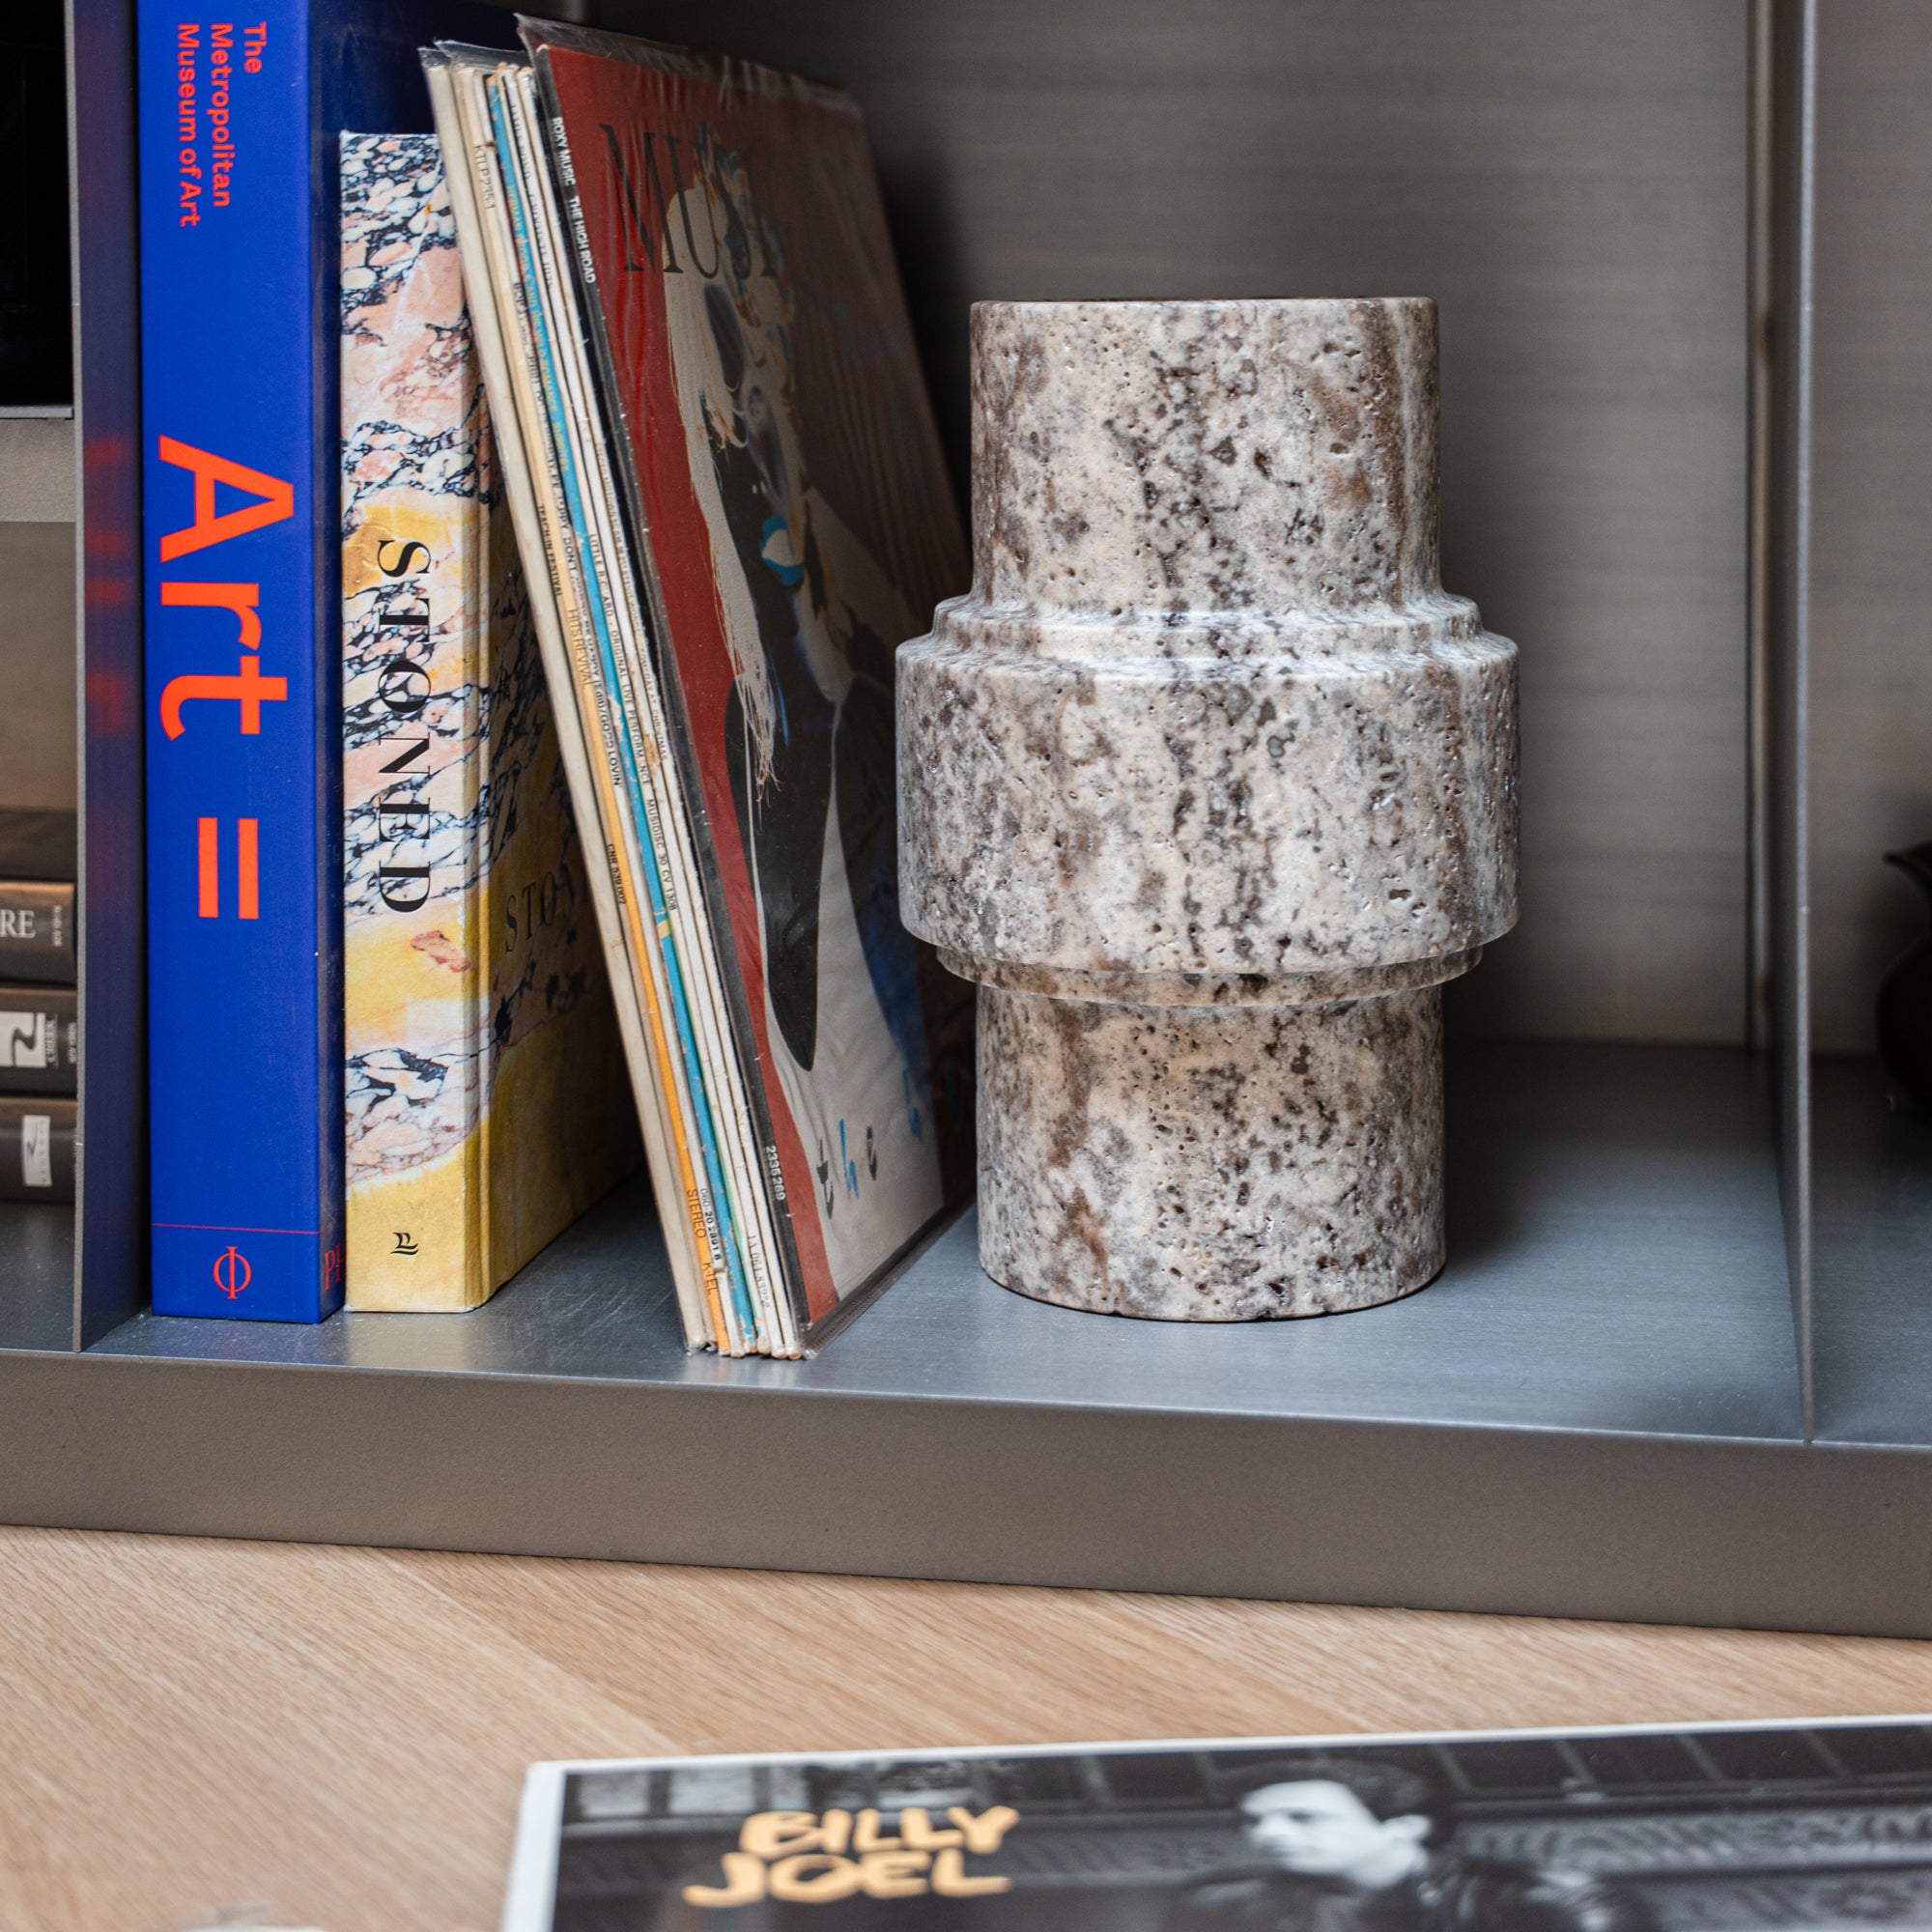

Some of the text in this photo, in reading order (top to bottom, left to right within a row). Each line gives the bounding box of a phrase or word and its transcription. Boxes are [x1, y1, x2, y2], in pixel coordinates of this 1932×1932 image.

[244, 21, 266, 72] The
[178, 24, 202, 226] Museum of Art
[207, 23, 235, 206] Metropolitan
[551, 116, 596, 283] ROXY MUSIC THE HIGH ROAD
[158, 435, 294, 740] Art
[546, 552, 563, 598] FESTIVAL
[565, 609, 583, 637] HITS
[573, 638, 594, 687] REVIVAL
[609, 629, 628, 677] ORIGINAL
[620, 683, 634, 703] LIVE
[378, 538, 431, 912] STONED
[644, 798, 665, 849] MUSIDISC
[606, 843, 618, 864] CNR
[657, 854, 668, 866] 30
[661, 869, 672, 883] CV
[665, 888, 678, 910] 1308
[0, 909, 37, 940] RE
[686, 1188, 707, 1238] STEREO
[739, 1805, 1019, 1859] BILLY
[682, 1849, 1012, 1907] JOEL
